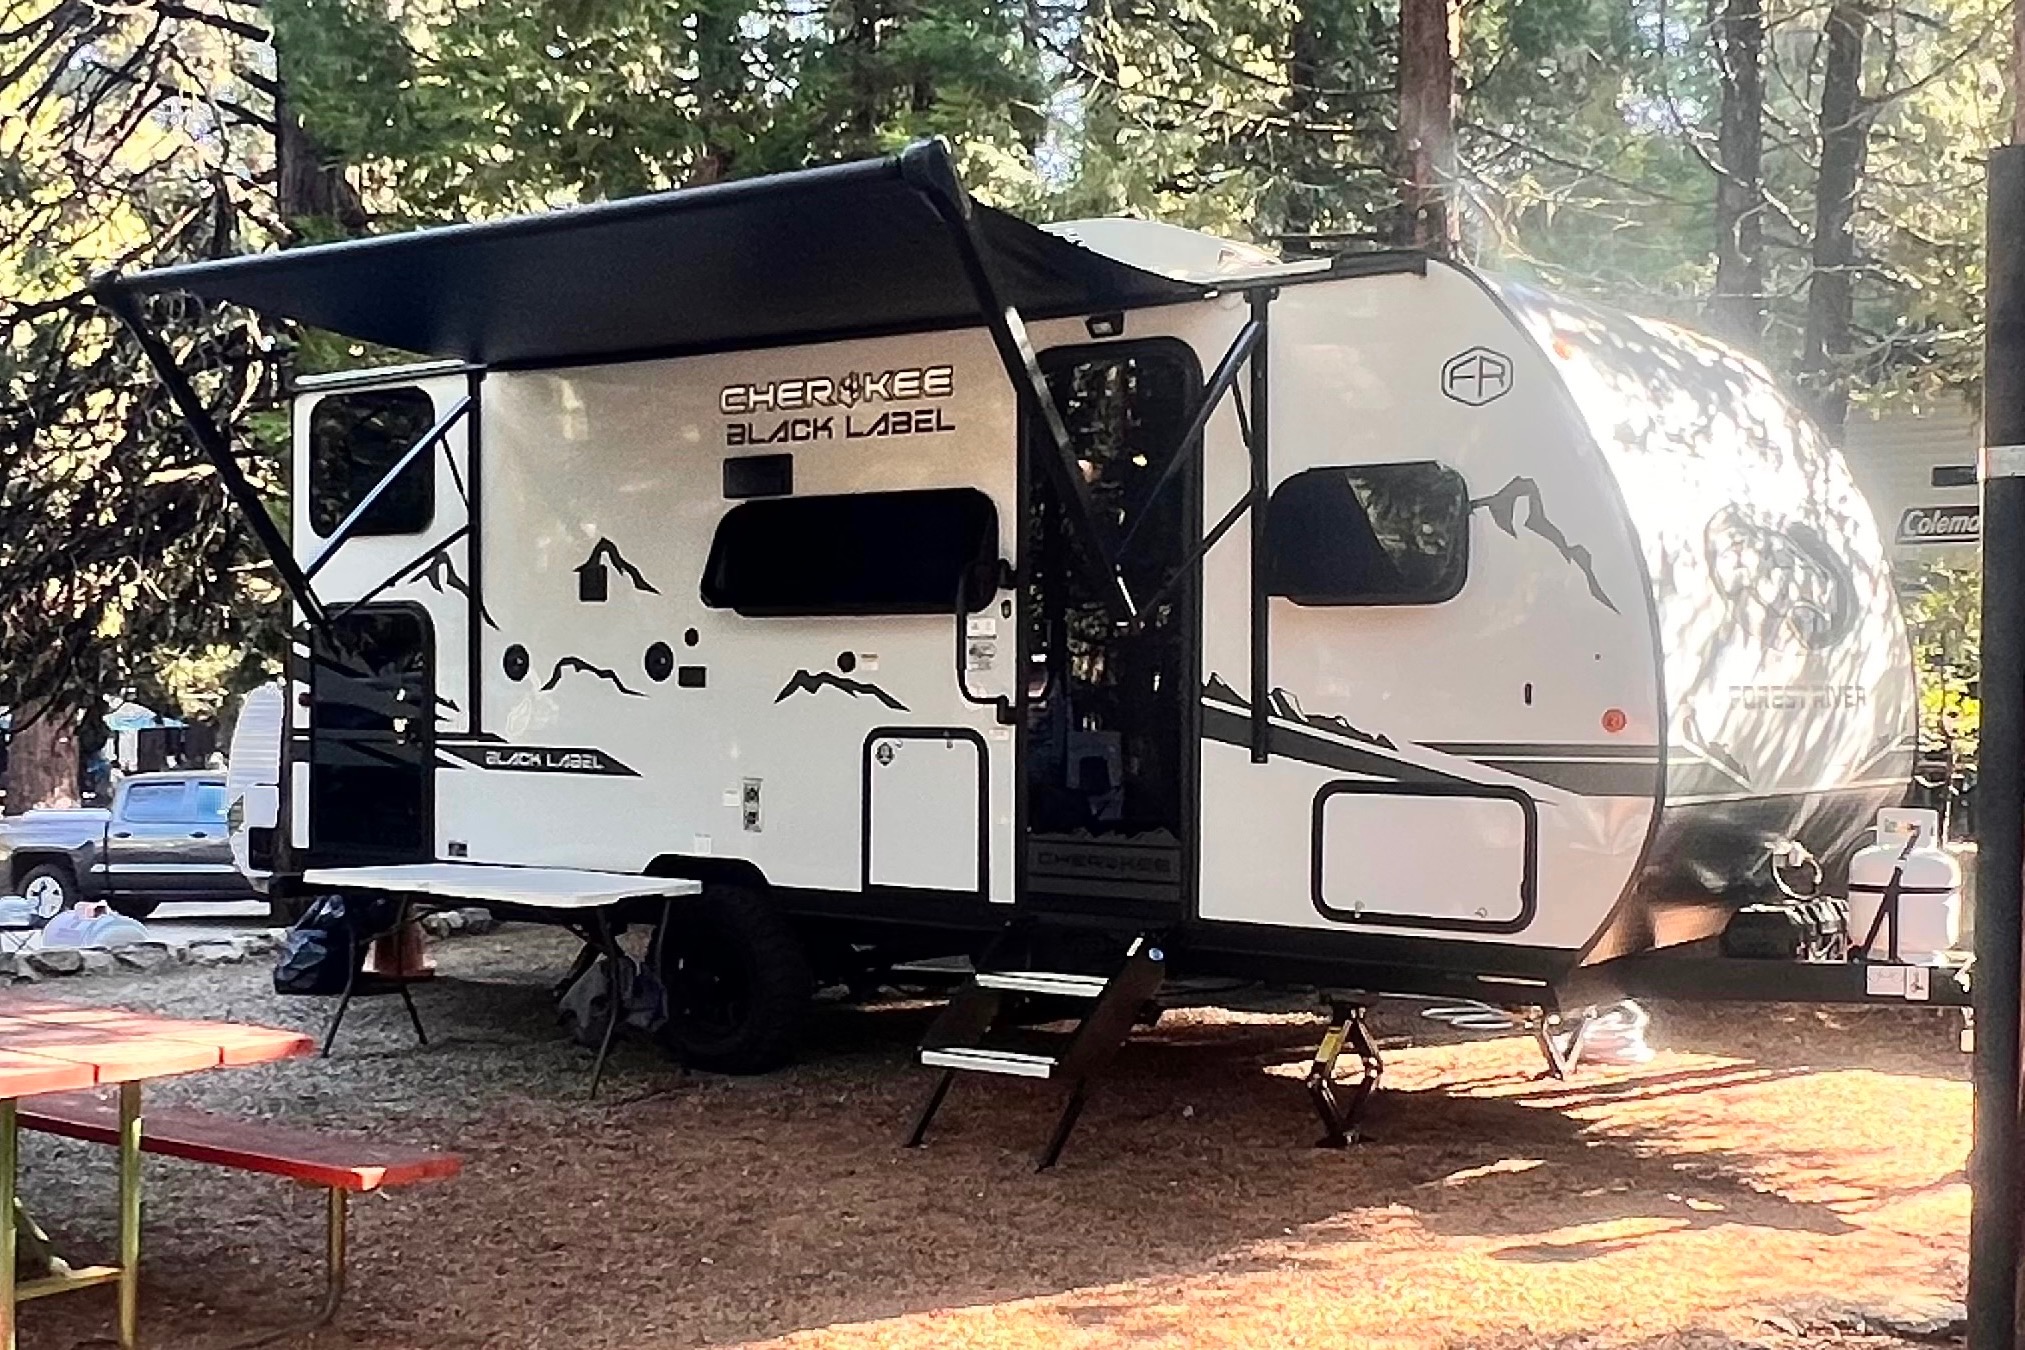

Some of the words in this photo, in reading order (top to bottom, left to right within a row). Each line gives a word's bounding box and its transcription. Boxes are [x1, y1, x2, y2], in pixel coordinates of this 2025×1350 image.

[720, 365, 953, 414] CHEROKEE
[726, 416, 833, 445] BLACK
[846, 408, 956, 438] LABEL
[1904, 510, 1979, 535] Colema
[1728, 685, 1808, 709] FOREST
[1811, 685, 1867, 709] RIVER
[484, 750, 542, 766] BLACK
[546, 753, 605, 769] LABEL
